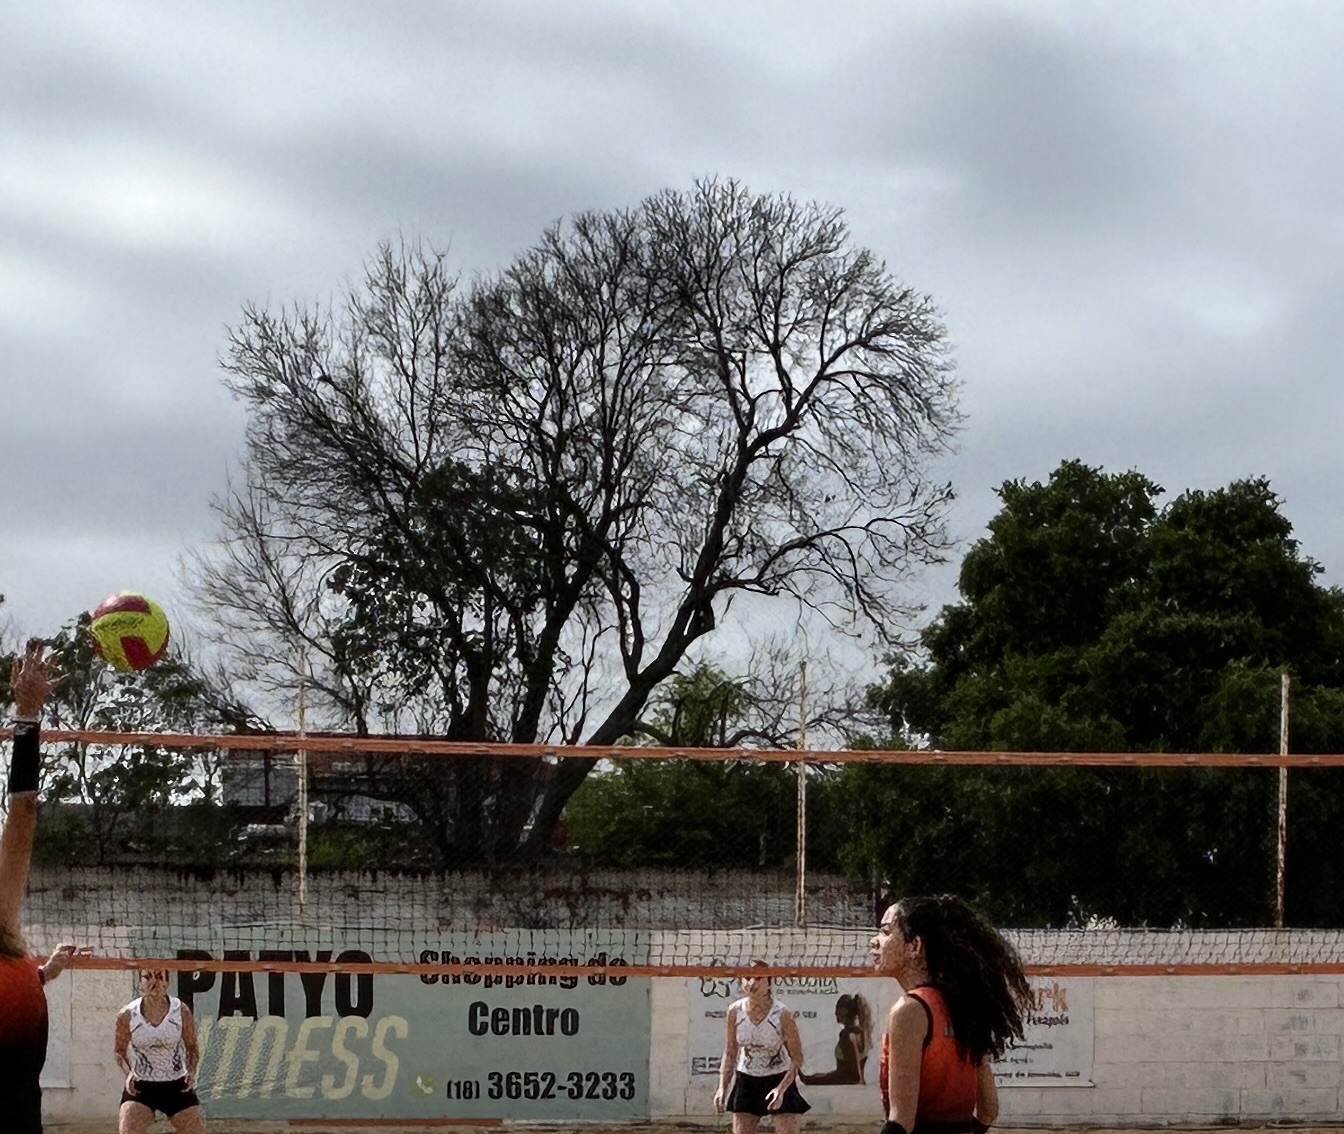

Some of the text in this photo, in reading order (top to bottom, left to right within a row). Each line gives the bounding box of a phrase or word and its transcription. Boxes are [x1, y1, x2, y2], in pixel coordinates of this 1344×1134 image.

[177, 950, 374, 1021] PATYO
[419, 950, 628, 989] Shopping de
[468, 1001, 580, 1036] Centro
[196, 1014, 409, 1100] ITNESS
[447, 1071, 635, 1100] (18) 3652-3233
